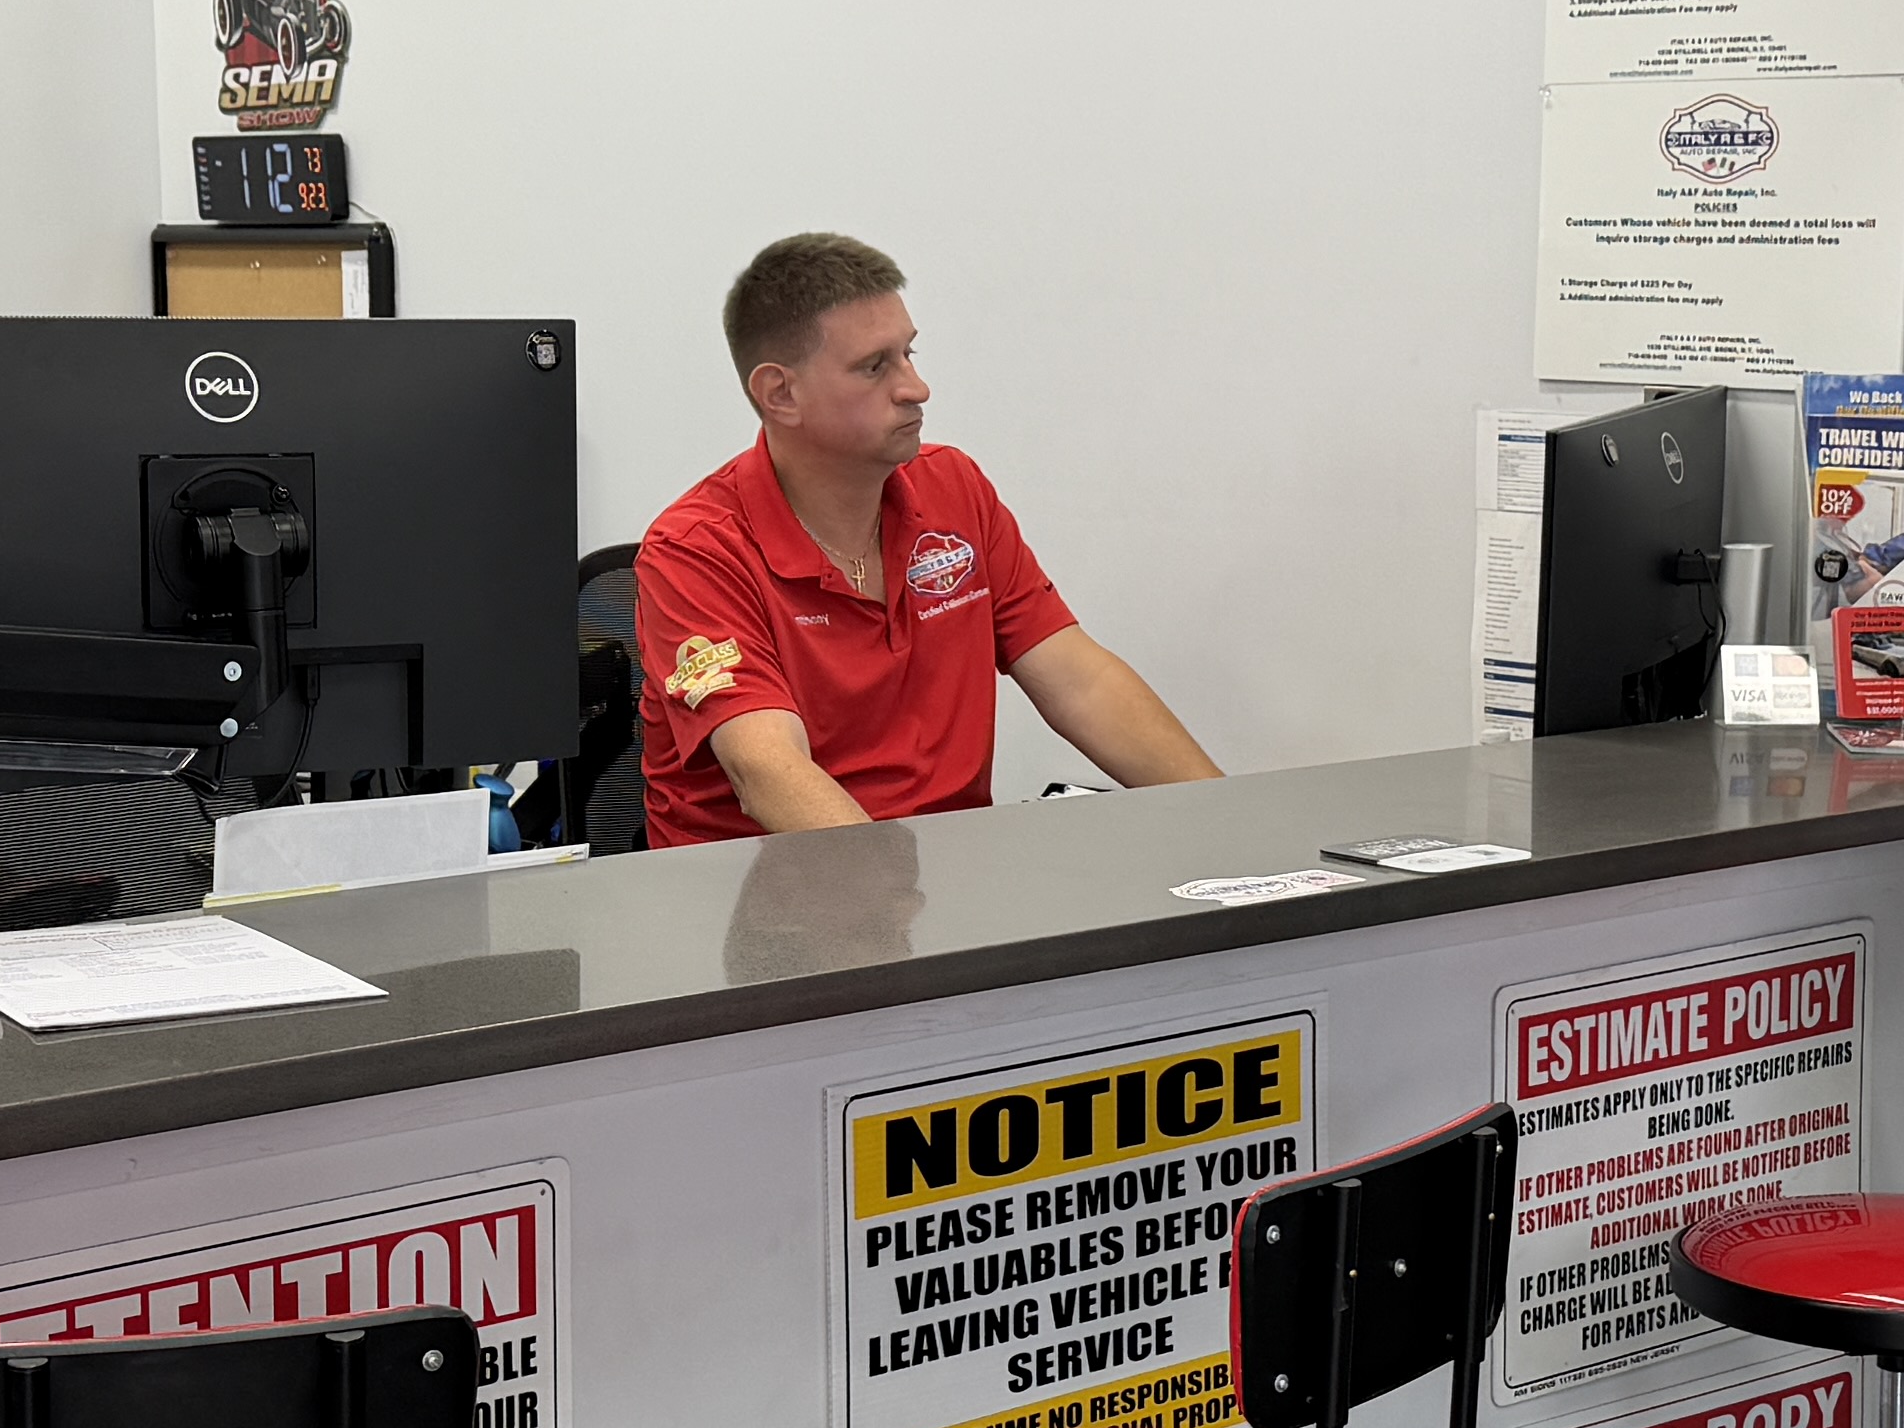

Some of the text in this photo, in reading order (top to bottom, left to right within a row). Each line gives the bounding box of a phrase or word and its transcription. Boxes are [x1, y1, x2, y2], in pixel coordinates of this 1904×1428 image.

[221, 59, 338, 109] SEMA
[238, 108, 321, 128] SHOW
[195, 377, 251, 396] DELL
[1819, 428, 1878, 447] TRAVEL
[1821, 489, 1853, 504] 10%
[1821, 502, 1851, 514] OFF
[1528, 965, 1846, 1087] ESTIMATE POLICY
[886, 1044, 1281, 1198] NOTICE
[1648, 1099, 1735, 1139] BEING DONE.
[865, 1137, 1296, 1268] PLEASE REMOVE YOUR
[895, 1225, 1124, 1315] VALUABLES
[869, 1255, 1208, 1377] LEAVING VEHICLE
[1007, 1316, 1174, 1393] SERVICE
